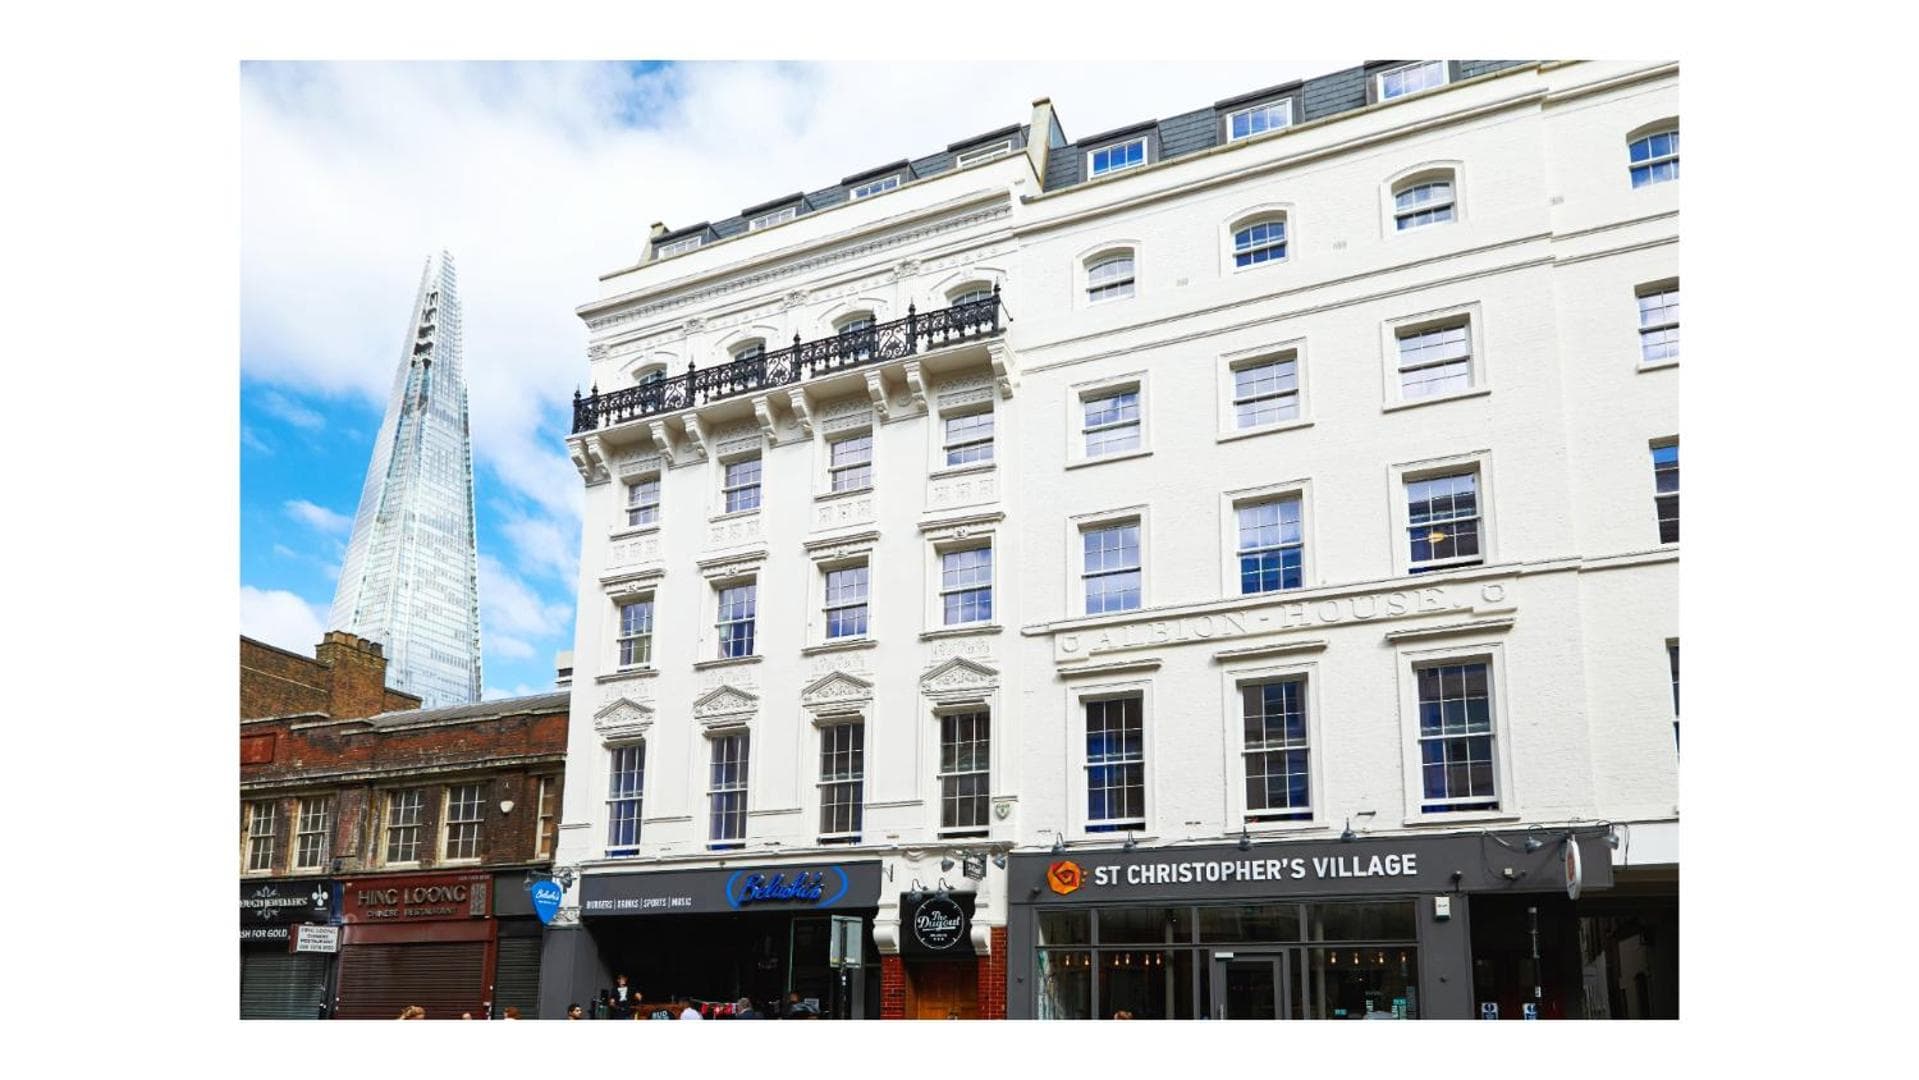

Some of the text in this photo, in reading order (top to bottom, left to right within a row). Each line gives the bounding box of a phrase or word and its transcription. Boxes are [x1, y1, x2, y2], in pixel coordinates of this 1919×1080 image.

[1093, 612, 1249, 651] ALBION
[1094, 854, 1417, 886] ST CHRISTOPHER'S VILLAGE
[358, 888, 398, 906] HING
[404, 884, 467, 904] LOONG
[644, 897, 667, 907] SPORTS
[917, 916, 960, 930] Dugout
[931, 911, 948, 921] The
[252, 930, 266, 938] FOR
[267, 929, 288, 938] GOLD
